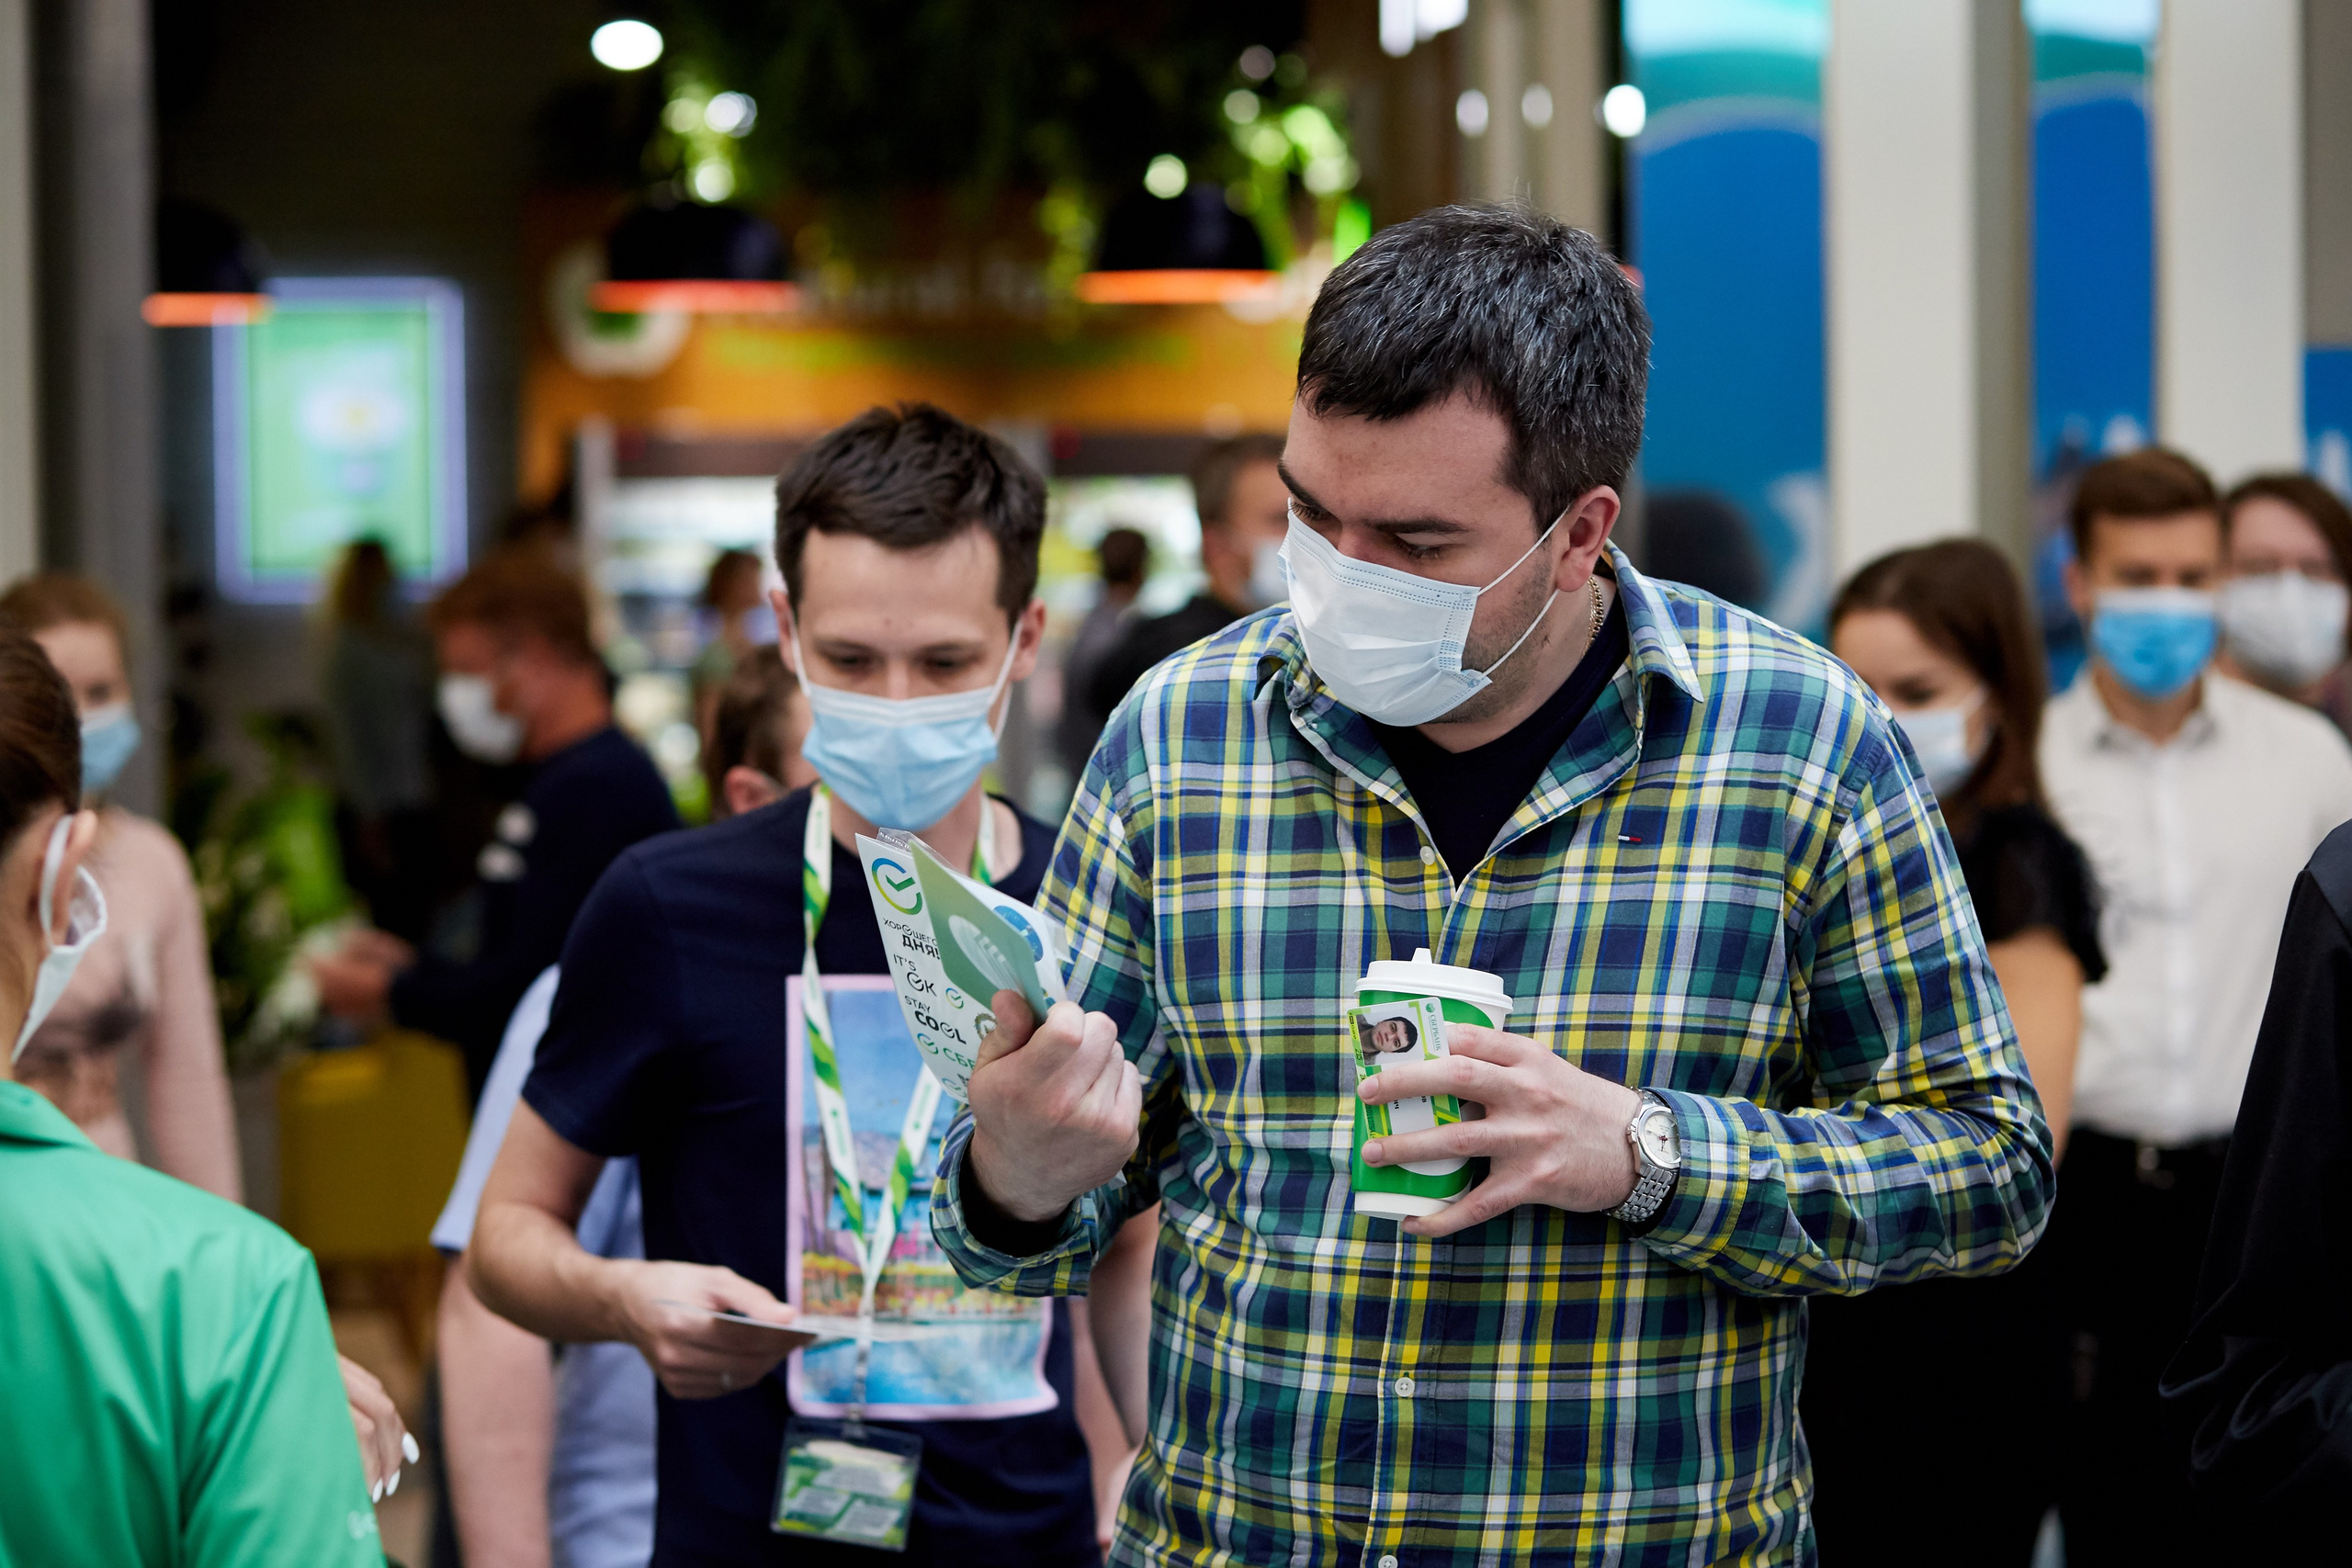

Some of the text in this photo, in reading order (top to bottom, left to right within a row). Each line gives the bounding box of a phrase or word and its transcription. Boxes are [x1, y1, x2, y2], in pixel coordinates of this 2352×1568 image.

[902, 934, 940, 960] ДНЯ!
[893, 953, 917, 972] IT'S
[904, 995, 931, 1013] STAY
[914, 1010, 967, 1044] COOL
[1430, 1014, 1442, 1051] СБЕРБАНК
[943, 1047, 976, 1070] СБЕ
